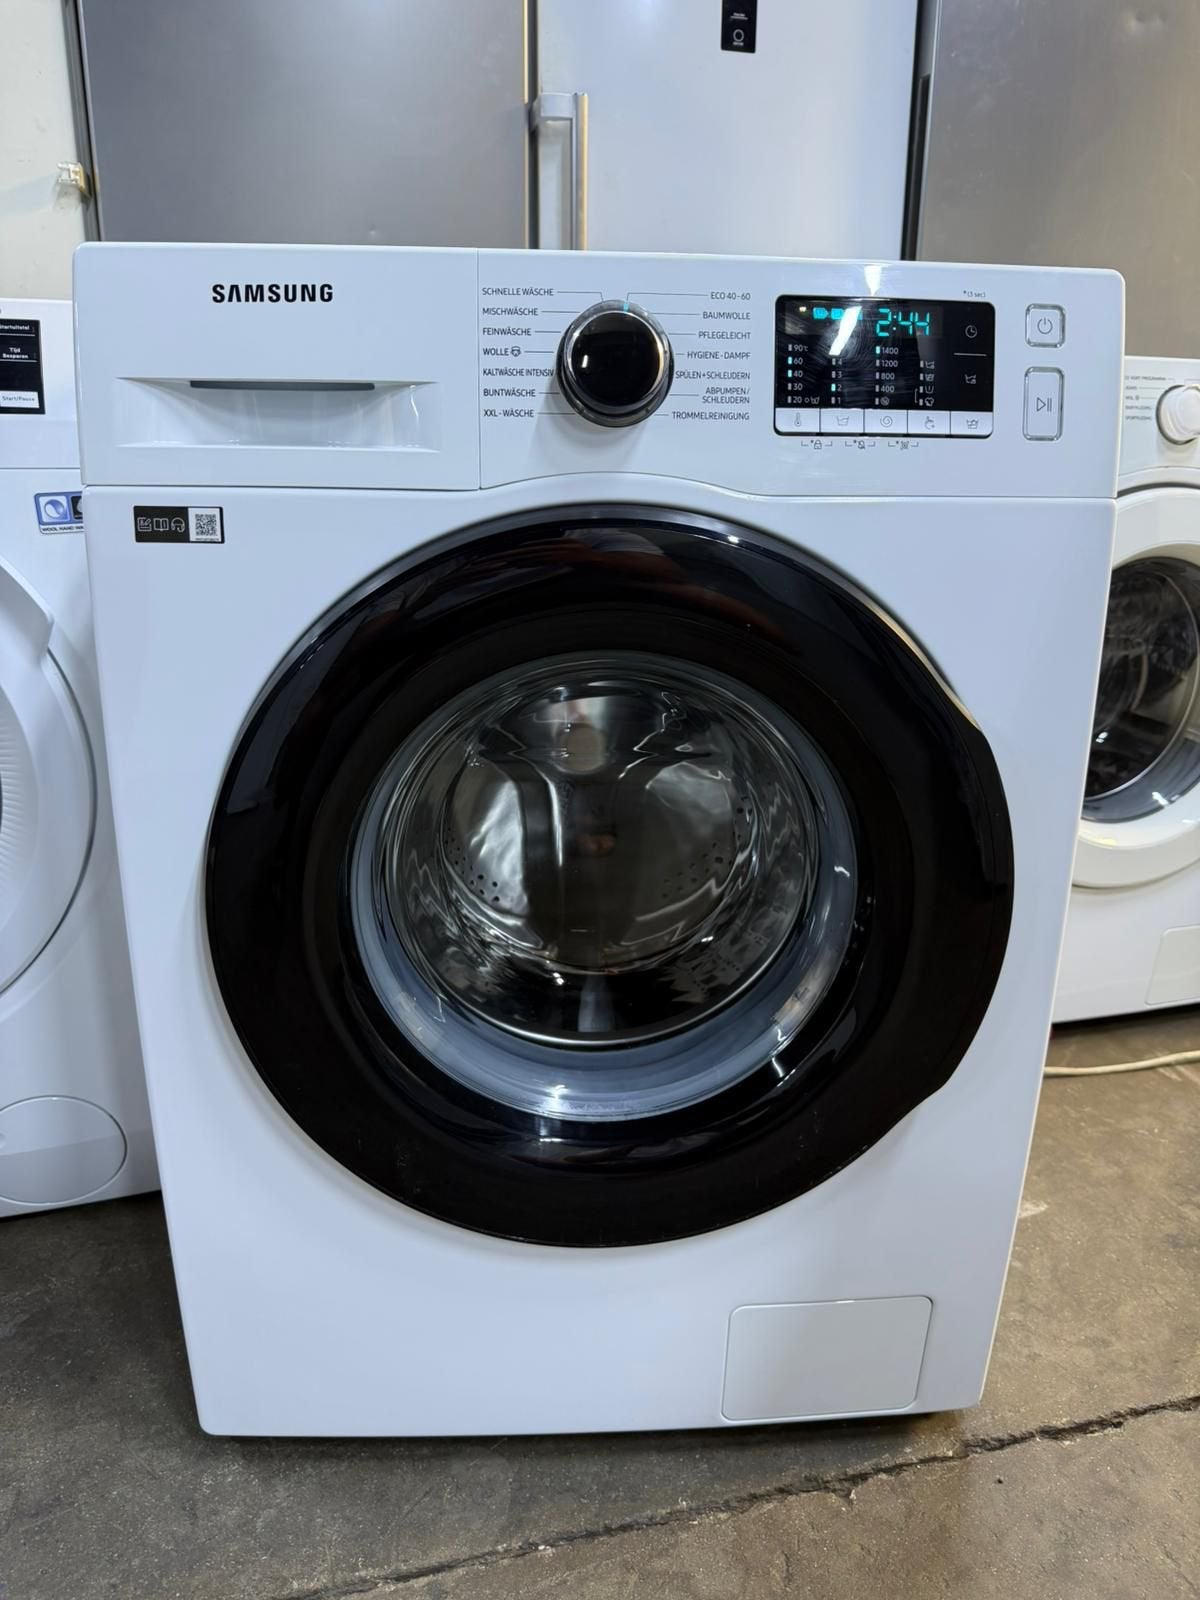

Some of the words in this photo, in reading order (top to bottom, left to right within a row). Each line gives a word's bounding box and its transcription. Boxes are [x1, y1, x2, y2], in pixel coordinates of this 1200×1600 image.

[212, 283, 333, 303] SAMSUNG
[482, 287, 521, 296] SCHNELLE
[522, 286, 554, 296] WÄSCHE
[710, 292, 726, 300] ECO
[482, 307, 538, 316] MISCHWÄSCHE
[702, 311, 751, 320] BAUMWOLLE
[876, 308, 930, 337] 2:44
[482, 327, 532, 336] FEINWÄSCHE
[698, 331, 751, 340] PFLEGELEICHT
[483, 347, 509, 356] WOLLE
[881, 347, 899, 355] 1400
[793, 357, 804, 365] 60
[483, 367, 524, 377] KALTWÄSCHE
[525, 368, 554, 377] INTENSIV
[793, 369, 804, 378] 40
[837, 371, 842, 379] 3
[881, 372, 895, 380] 800
[793, 382, 803, 391] 30
[837, 383, 842, 392] 2
[880, 385, 895, 393] 400
[483, 388, 536, 397] BUNTWÄSCHE
[702, 395, 750, 404] SCHLEUDERN
[792, 396, 803, 404] 20
[672, 411, 750, 420] TROMMELREINIGUNG
